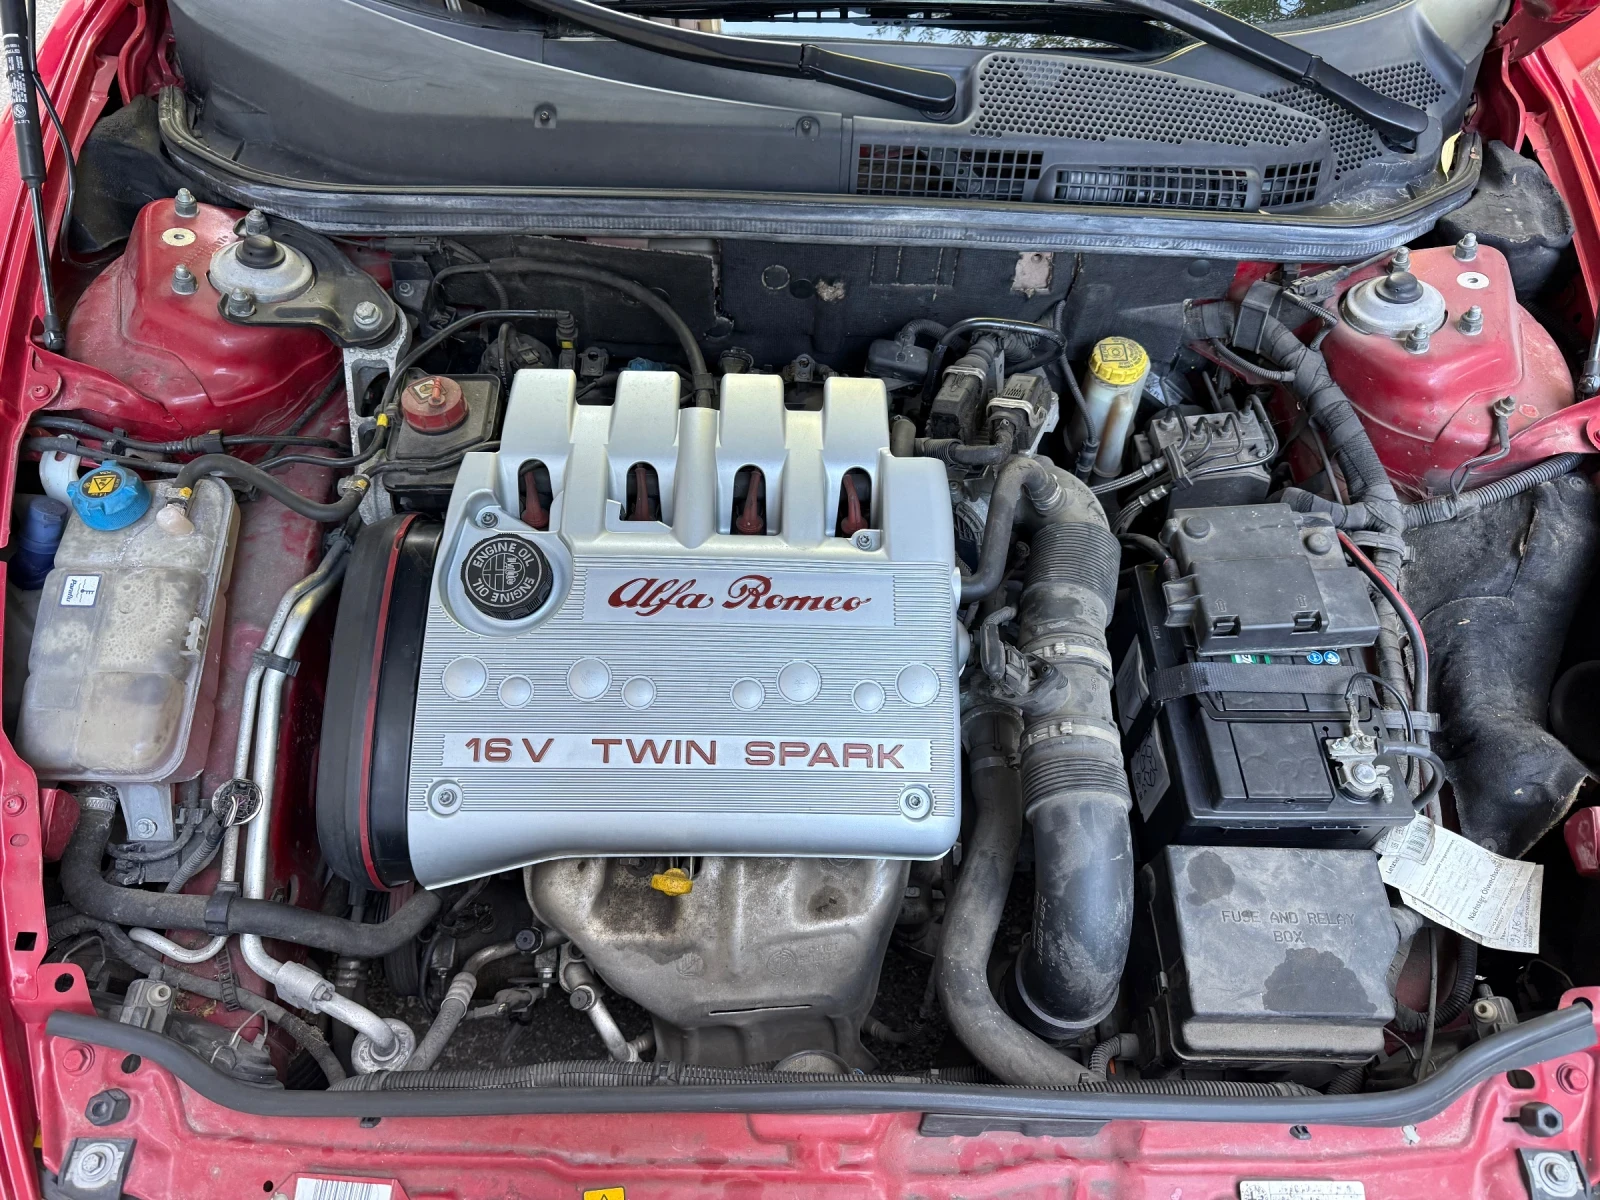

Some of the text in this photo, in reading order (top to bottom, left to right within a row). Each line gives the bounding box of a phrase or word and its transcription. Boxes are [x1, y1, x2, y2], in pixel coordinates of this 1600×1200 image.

[473, 542, 535, 568] ENGINE OIL
[473, 576, 535, 603] ENGINE OIL
[607, 574, 872, 616] Alfa Romeo
[591, 738, 716, 766] TWIN
[745, 741, 904, 769] SPARK
[1221, 910, 1355, 925] FUSE AND RELAY
[1468, 896, 1486, 921] Nächster
[1273, 930, 1305, 943] BOX
